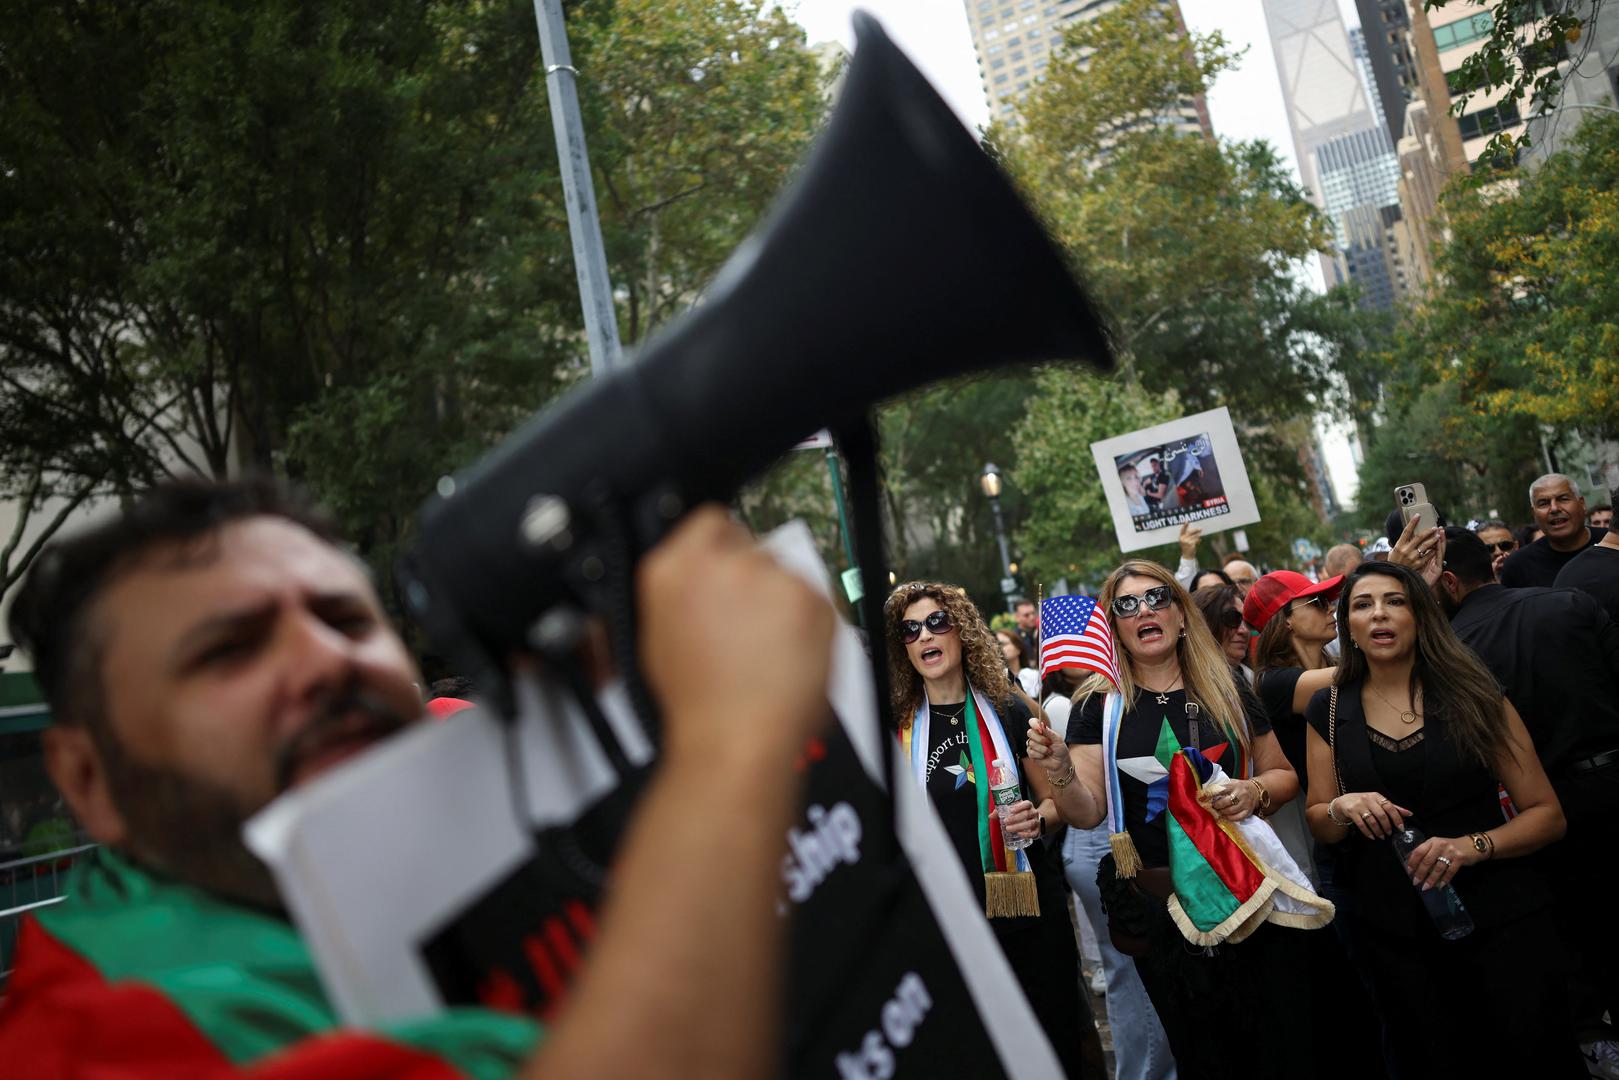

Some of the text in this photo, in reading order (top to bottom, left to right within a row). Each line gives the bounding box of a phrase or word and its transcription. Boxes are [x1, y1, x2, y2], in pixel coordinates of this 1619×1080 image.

[1205, 497, 1226, 507] SYRIA
[1141, 517, 1167, 530] LIGHT
[955, 731, 969, 744] th
[881, 972, 932, 1047] on
